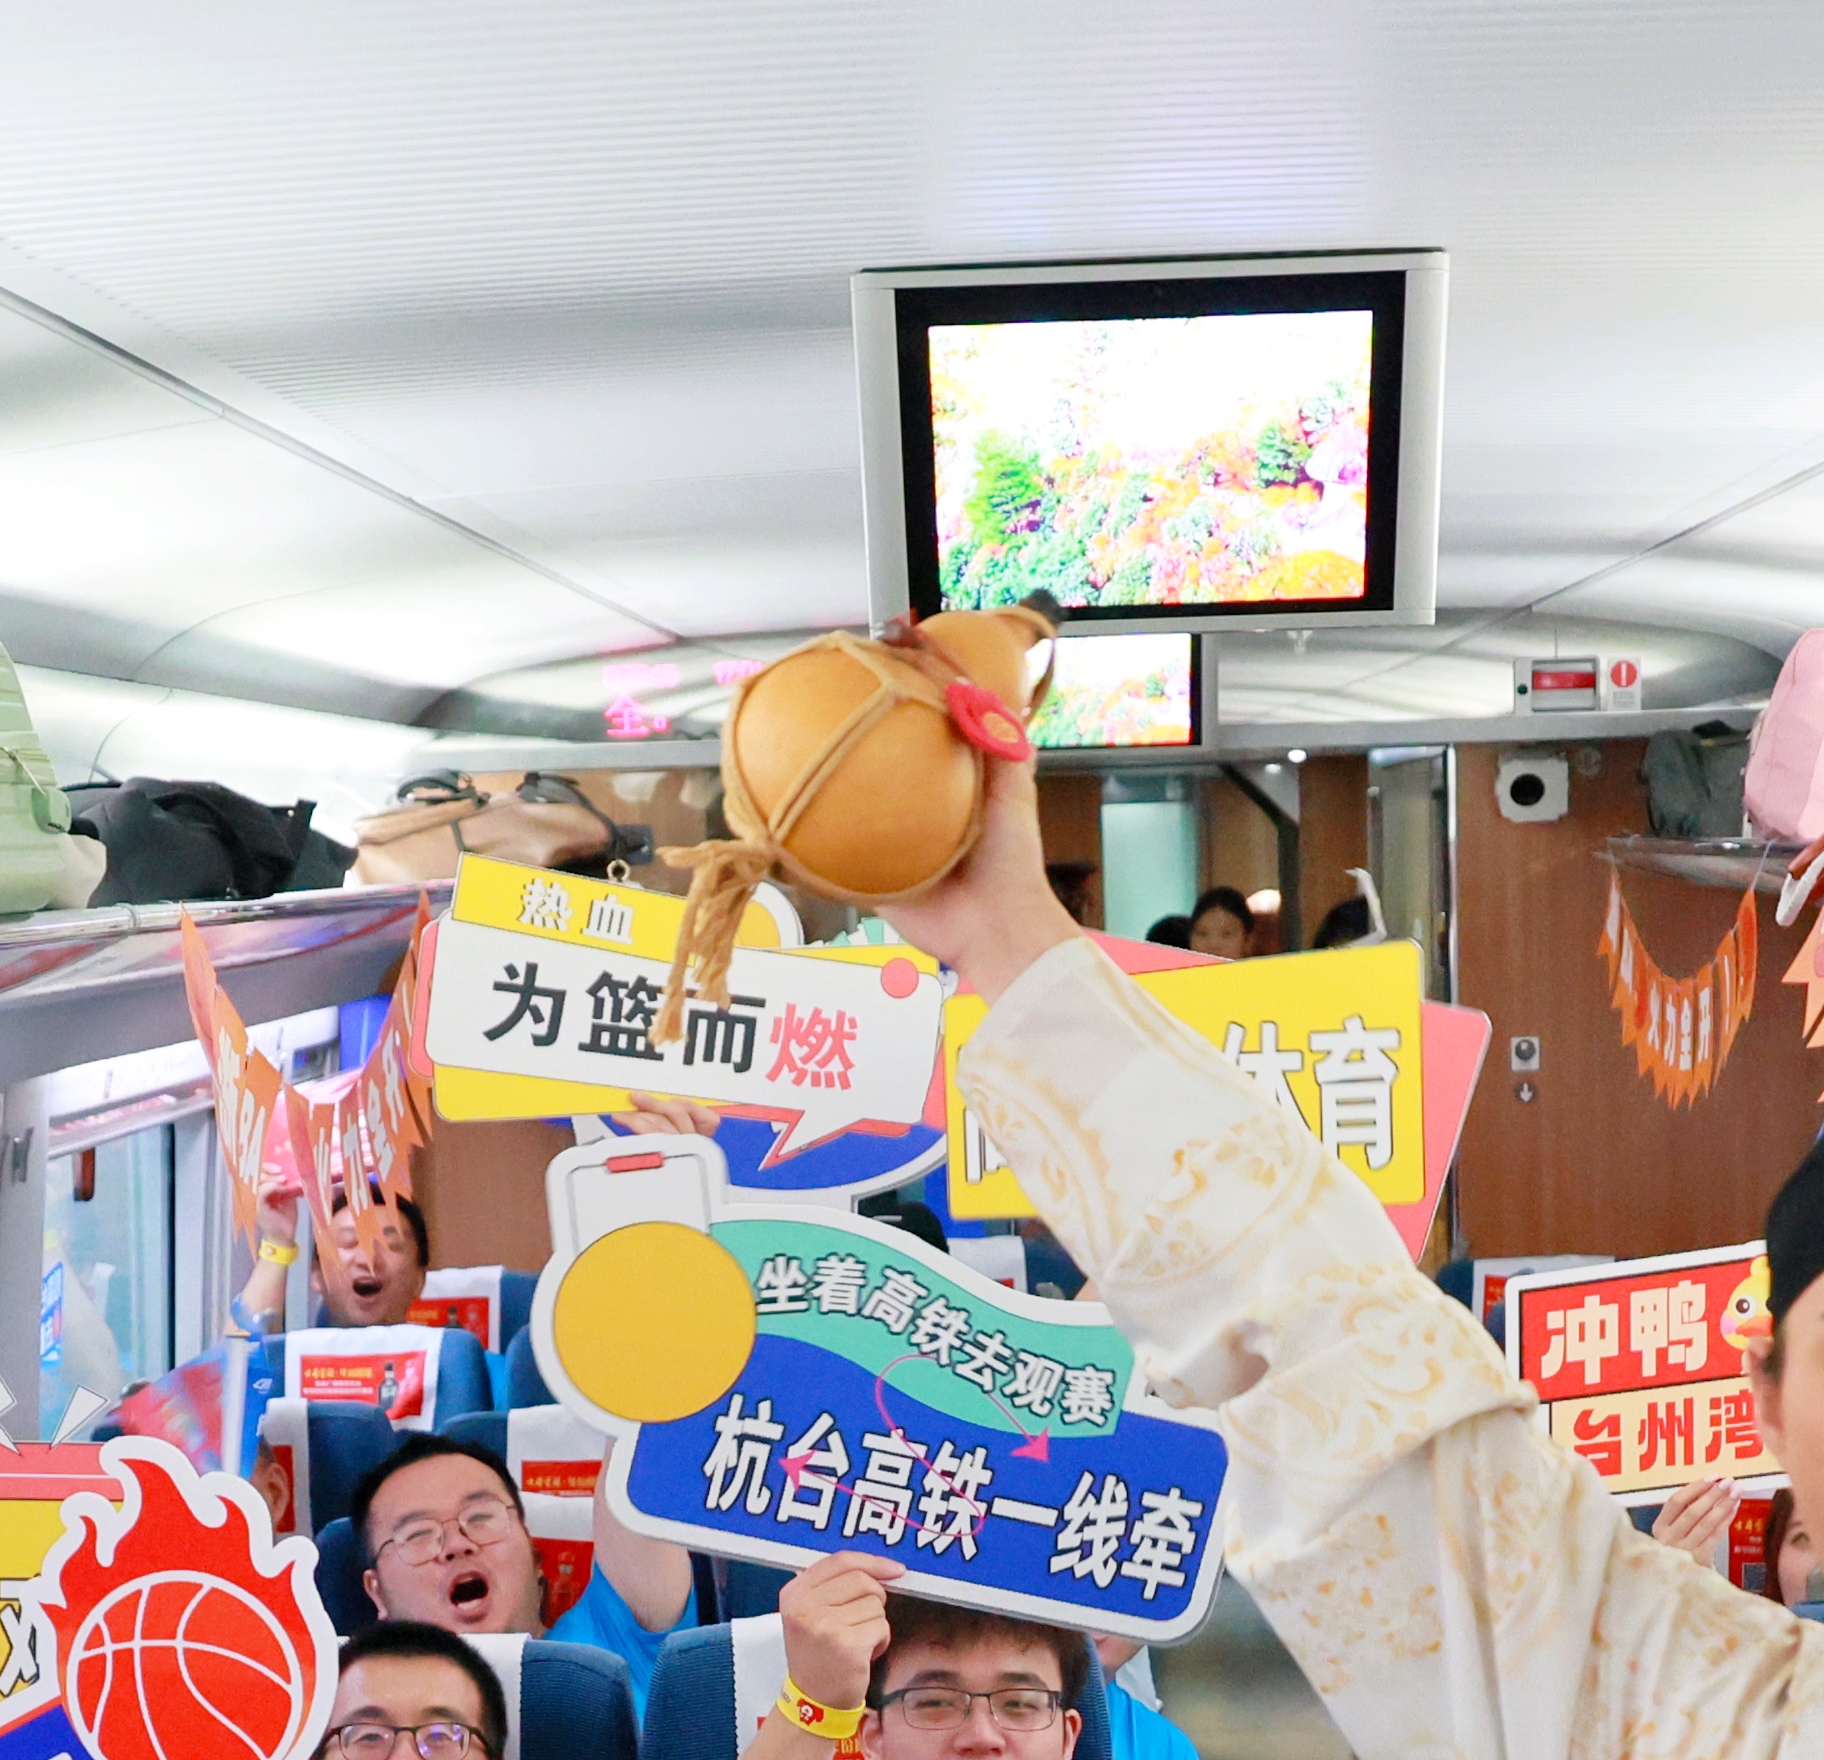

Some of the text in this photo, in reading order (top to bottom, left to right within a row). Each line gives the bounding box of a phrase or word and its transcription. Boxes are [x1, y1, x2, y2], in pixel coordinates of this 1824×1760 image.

[518, 877, 635, 946] 热血
[484, 961, 858, 1091] 为篮而燃
[754, 1251, 1118, 1429] 坐着高铁去观赛
[1541, 1279, 1709, 1386] 冲鸭
[702, 1392, 1205, 1602] 杭台高铁一线牵
